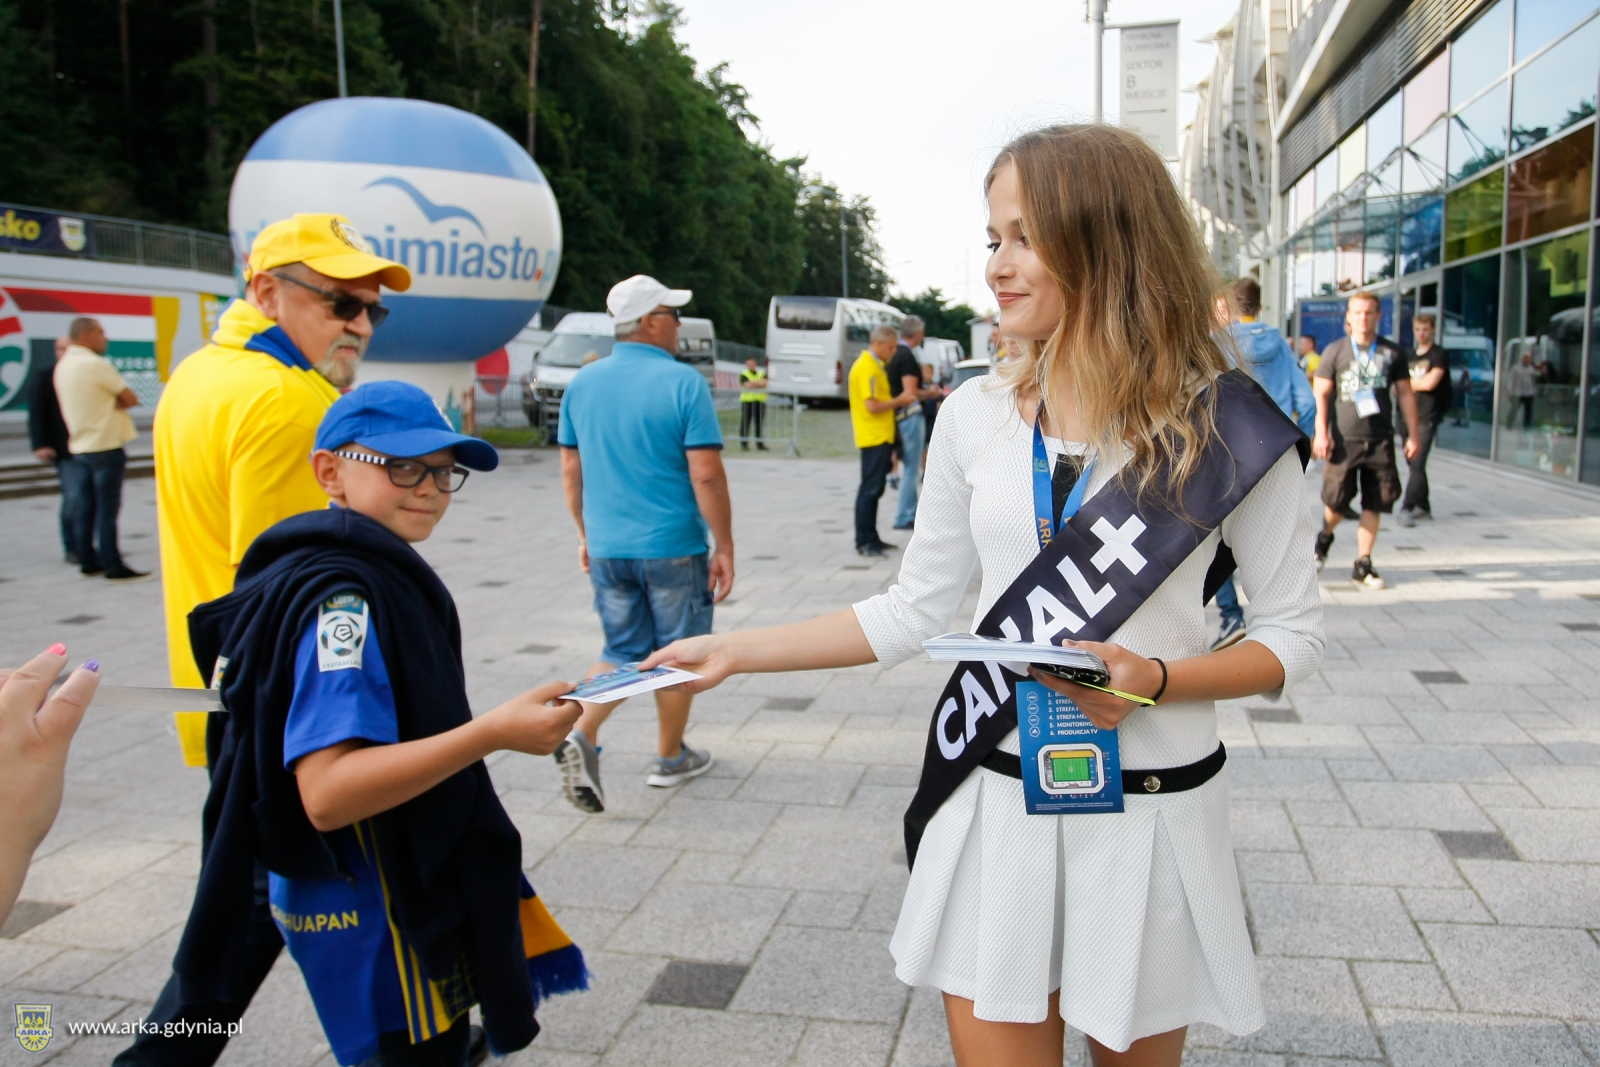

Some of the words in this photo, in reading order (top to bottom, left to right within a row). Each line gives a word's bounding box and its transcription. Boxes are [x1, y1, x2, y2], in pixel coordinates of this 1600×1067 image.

[1126, 60, 1164, 70] SEKTOR
[1126, 75, 1136, 88] B
[1038, 518, 1053, 549] ARK
[271, 904, 359, 933] HUAPAN
